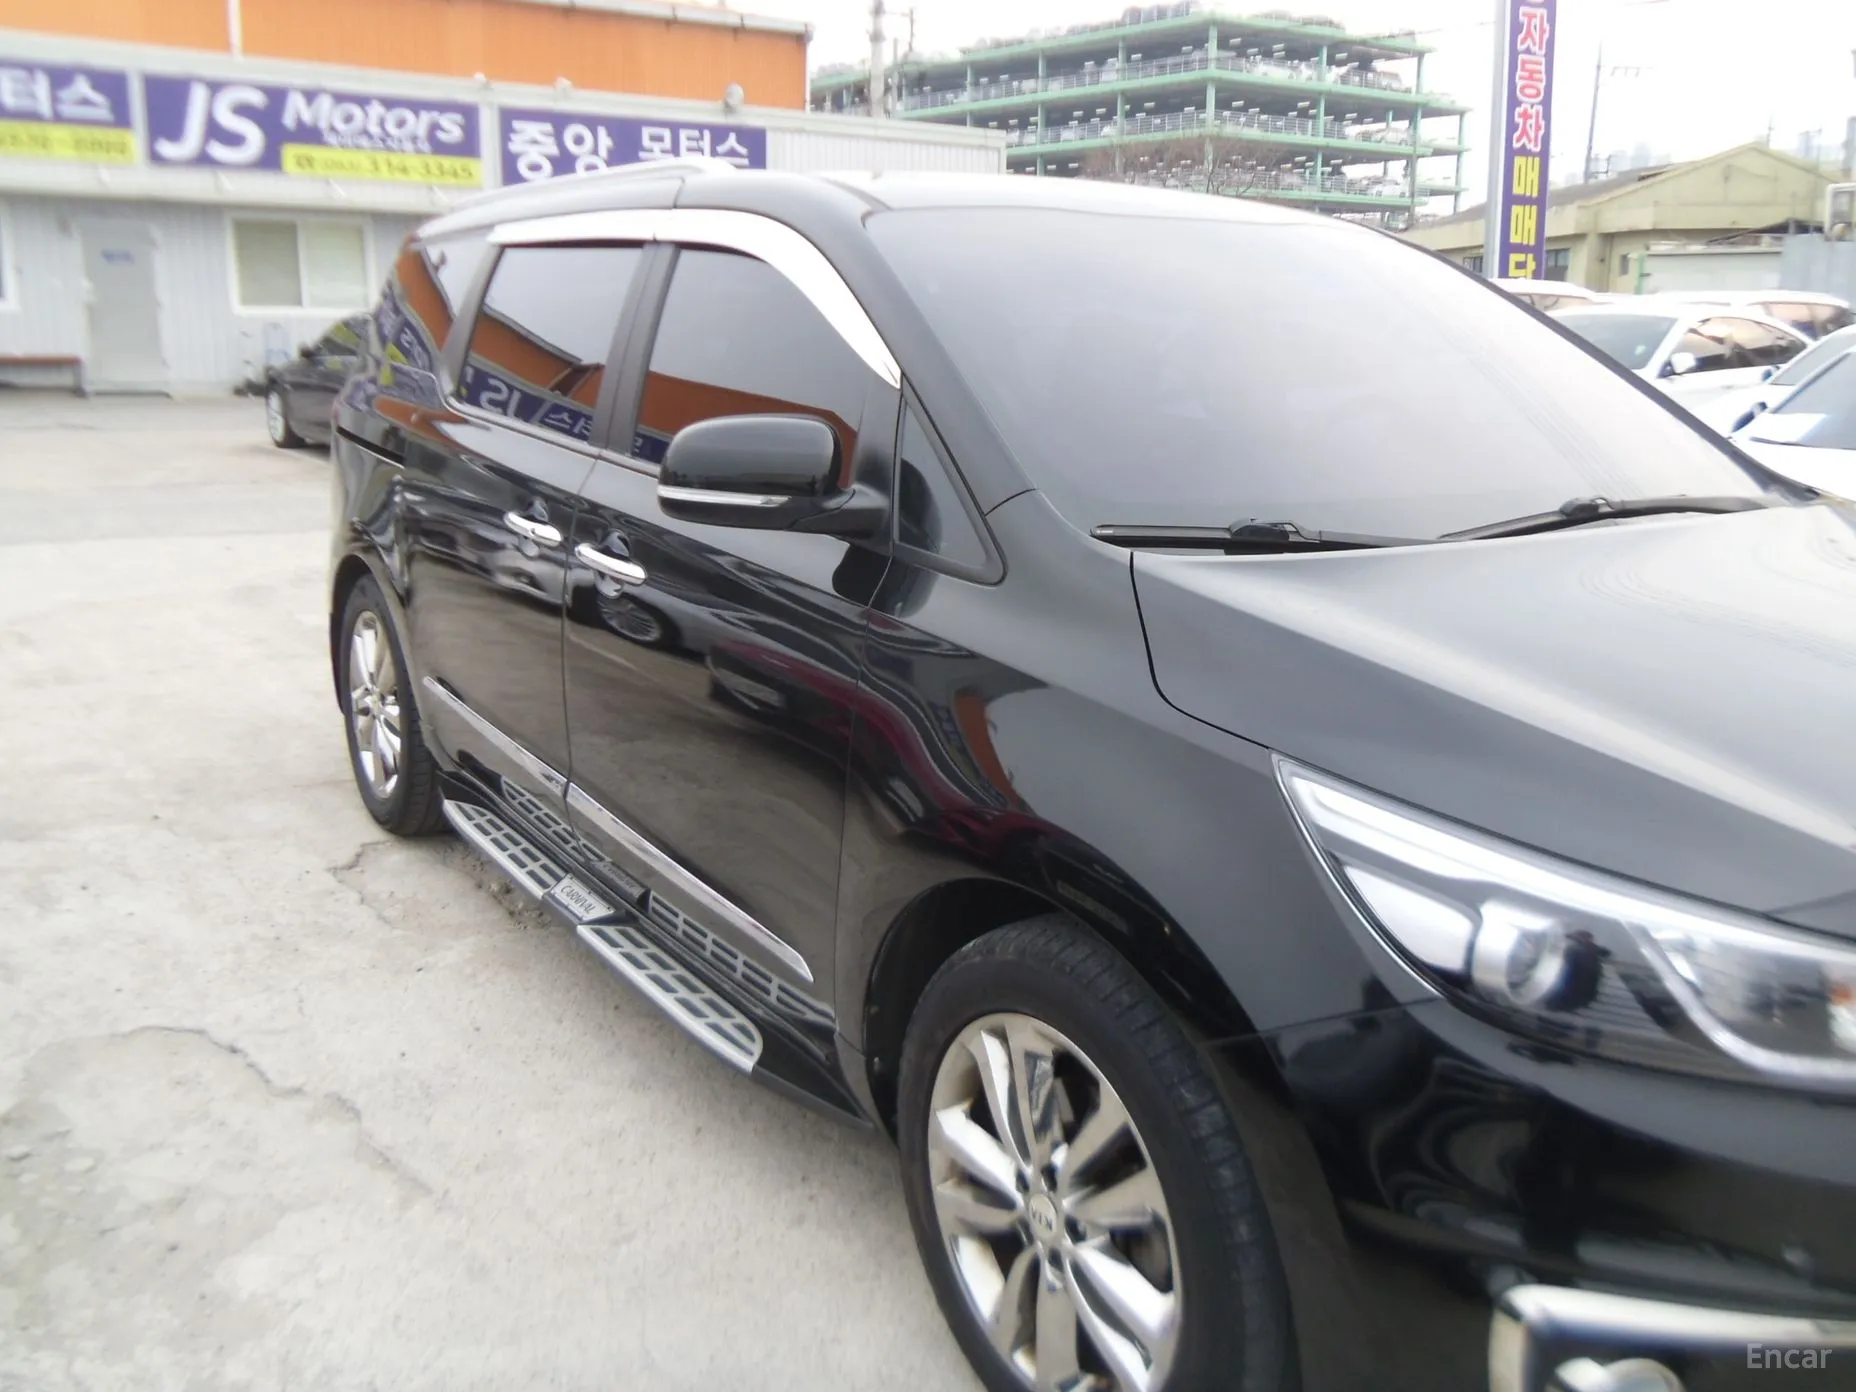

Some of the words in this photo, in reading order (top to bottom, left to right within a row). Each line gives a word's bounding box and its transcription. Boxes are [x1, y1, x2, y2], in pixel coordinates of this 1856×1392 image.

[1513, 6, 1549, 151] 자동차
[153, 81, 269, 165] JS
[282, 89, 466, 144] Motors
[507, 119, 614, 182] 중앙
[638, 125, 750, 167] 모터스
